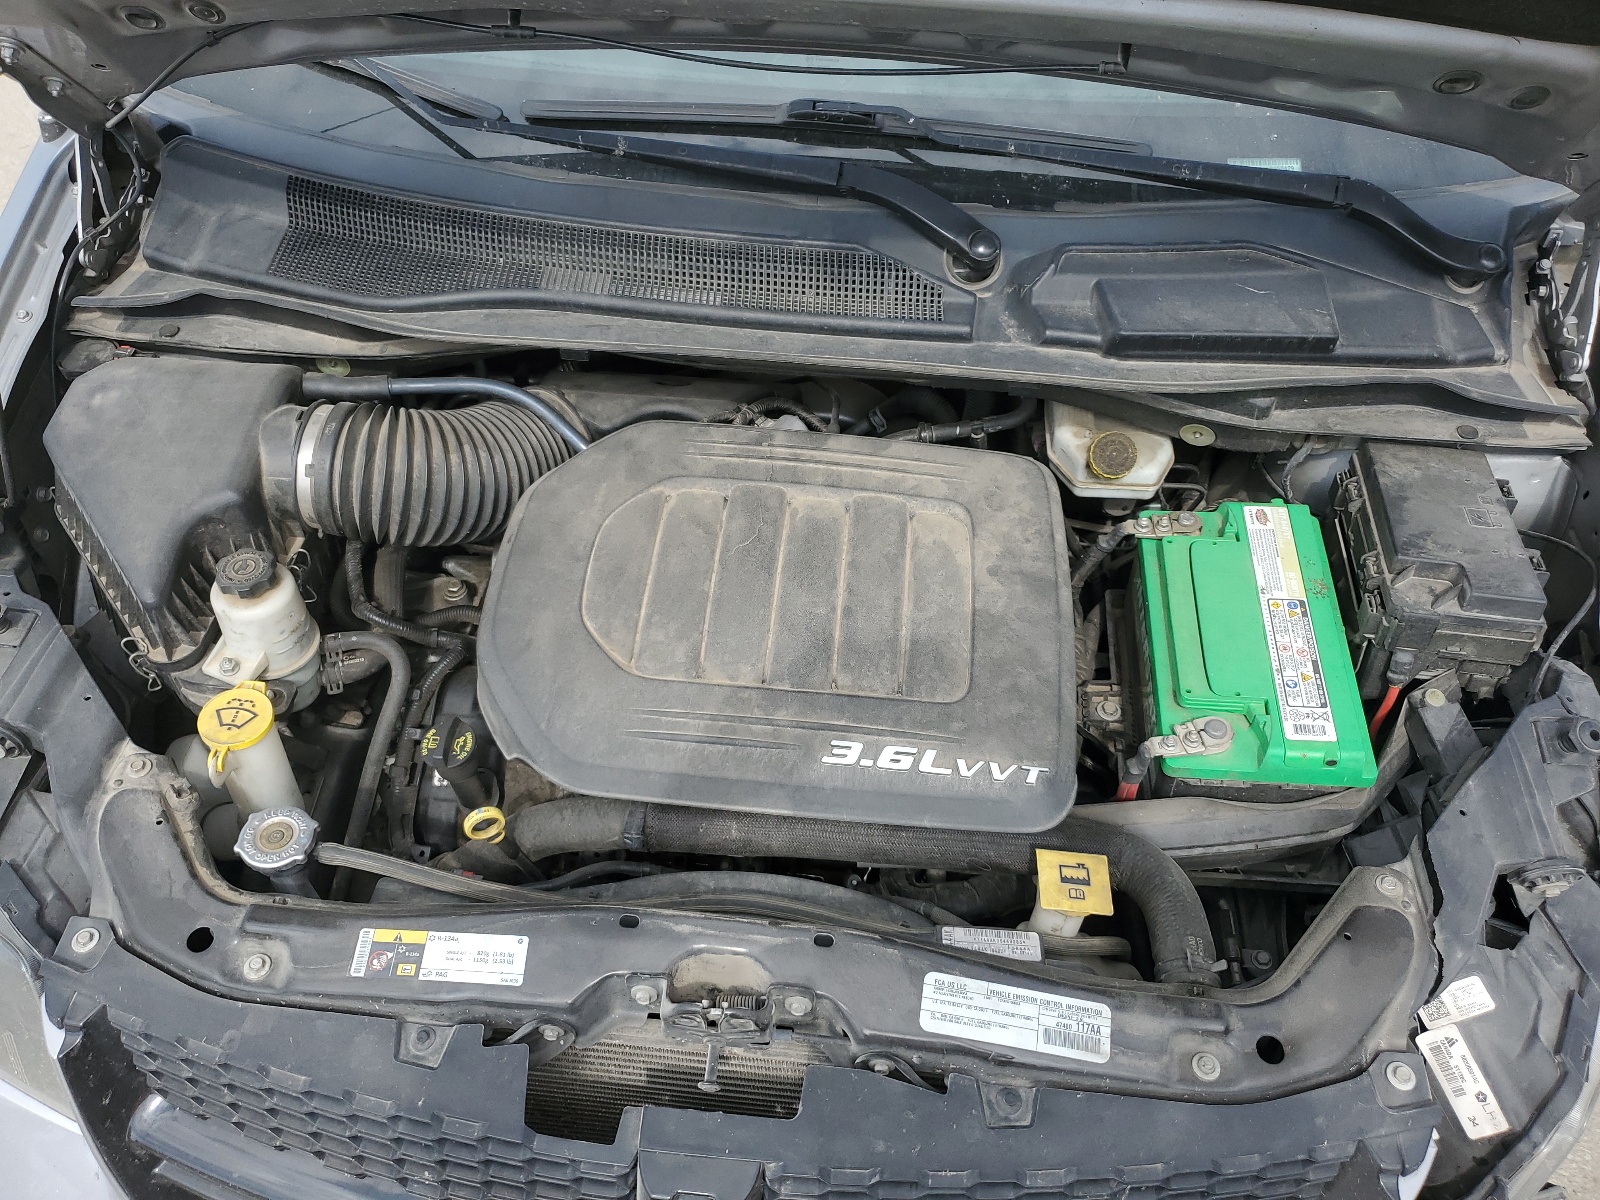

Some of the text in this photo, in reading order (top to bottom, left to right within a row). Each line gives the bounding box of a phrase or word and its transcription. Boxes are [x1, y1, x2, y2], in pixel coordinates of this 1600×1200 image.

[456, 731, 473, 761] ENGINE OIL
[264, 810, 290, 819] KEEP
[255, 853, 281, 862] OPEN
[282, 843, 300, 858] HOT
[934, 978, 968, 991] FCA US LLC
[989, 988, 1011, 999] VEHICLE
[1012, 992, 1038, 1004] EMISSION
[1039, 998, 1064, 1009] CONTROL
[1065, 1003, 1103, 1016] INFORMATION
